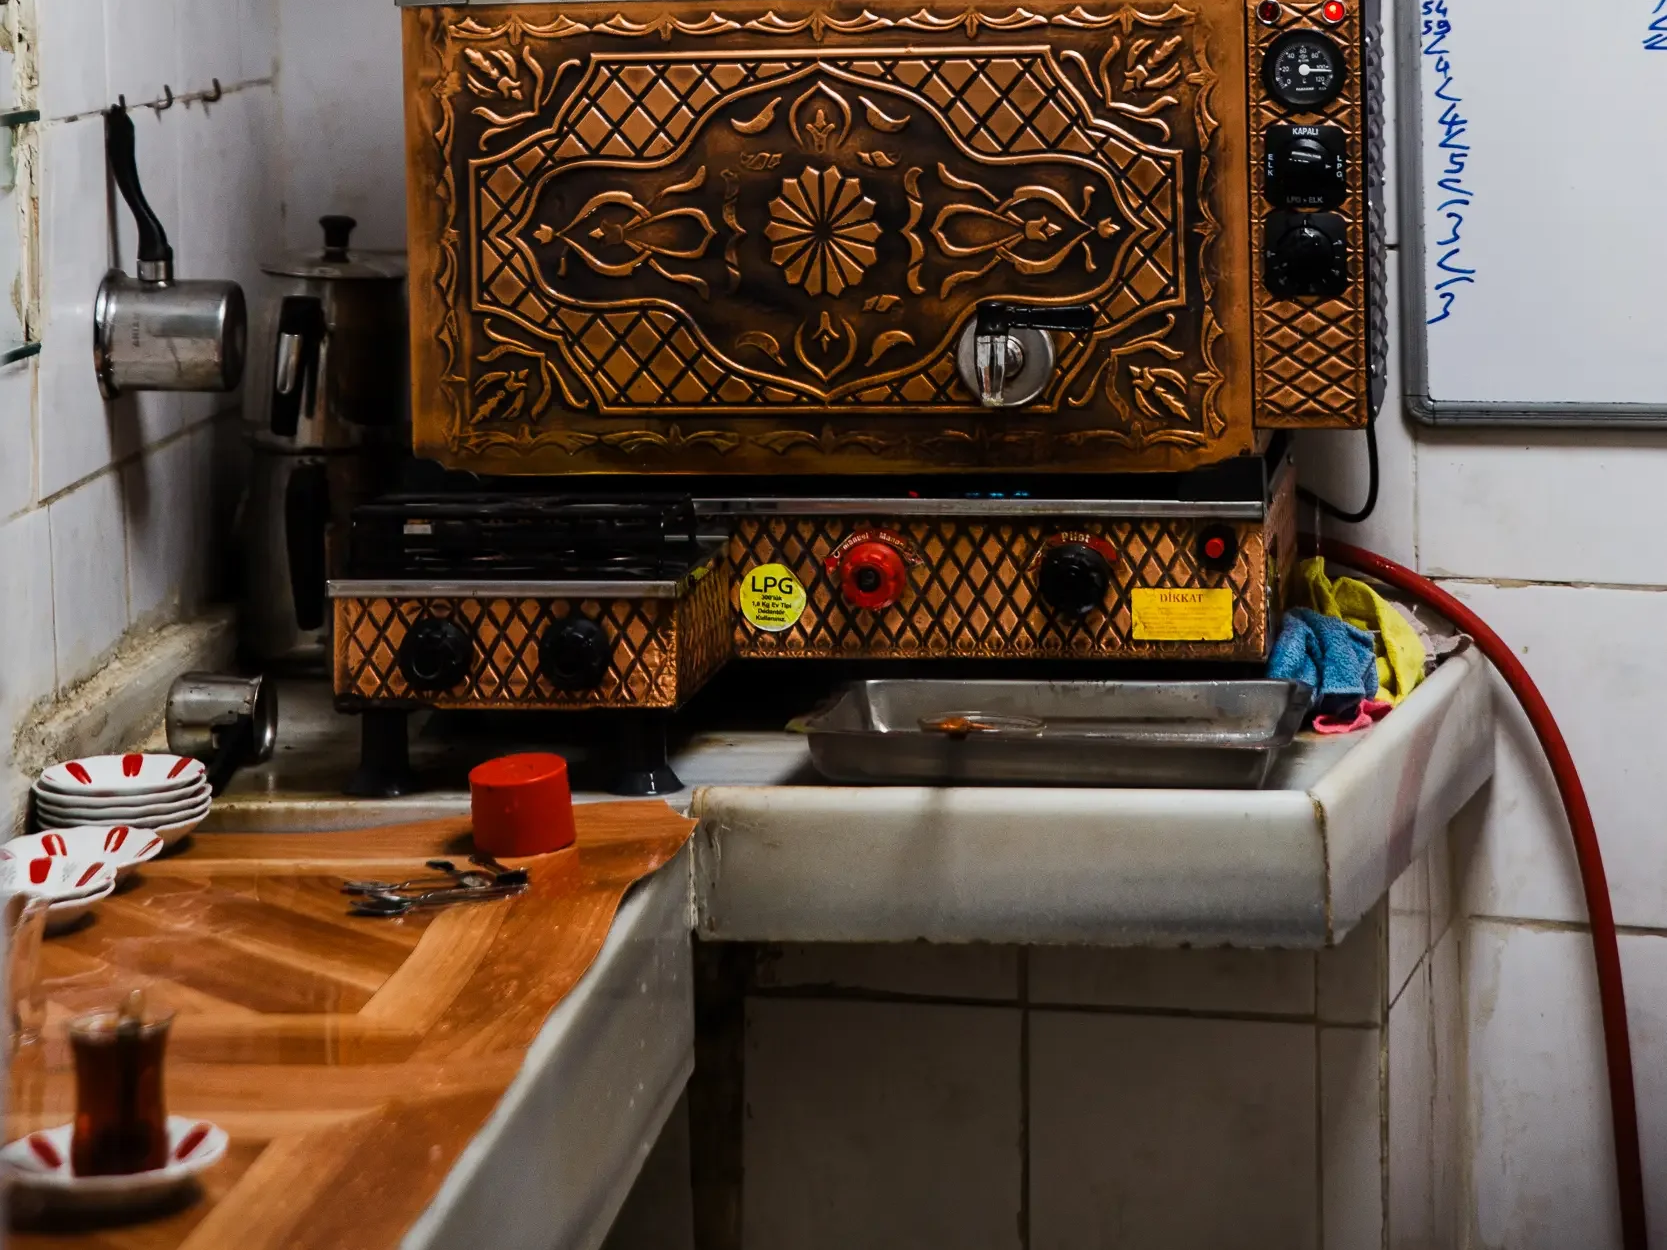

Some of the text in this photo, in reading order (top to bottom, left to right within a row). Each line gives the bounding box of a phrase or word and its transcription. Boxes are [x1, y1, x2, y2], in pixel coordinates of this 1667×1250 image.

[1421, 0, 1448, 18] 54
[1292, 127, 1319, 136] KAPALI
[1308, 195, 1324, 204] ELK
[1061, 531, 1091, 543] Pilot
[751, 575, 793, 594] LPG
[1160, 592, 1204, 603] DİKKAT
[762, 601, 770, 609] Kg
